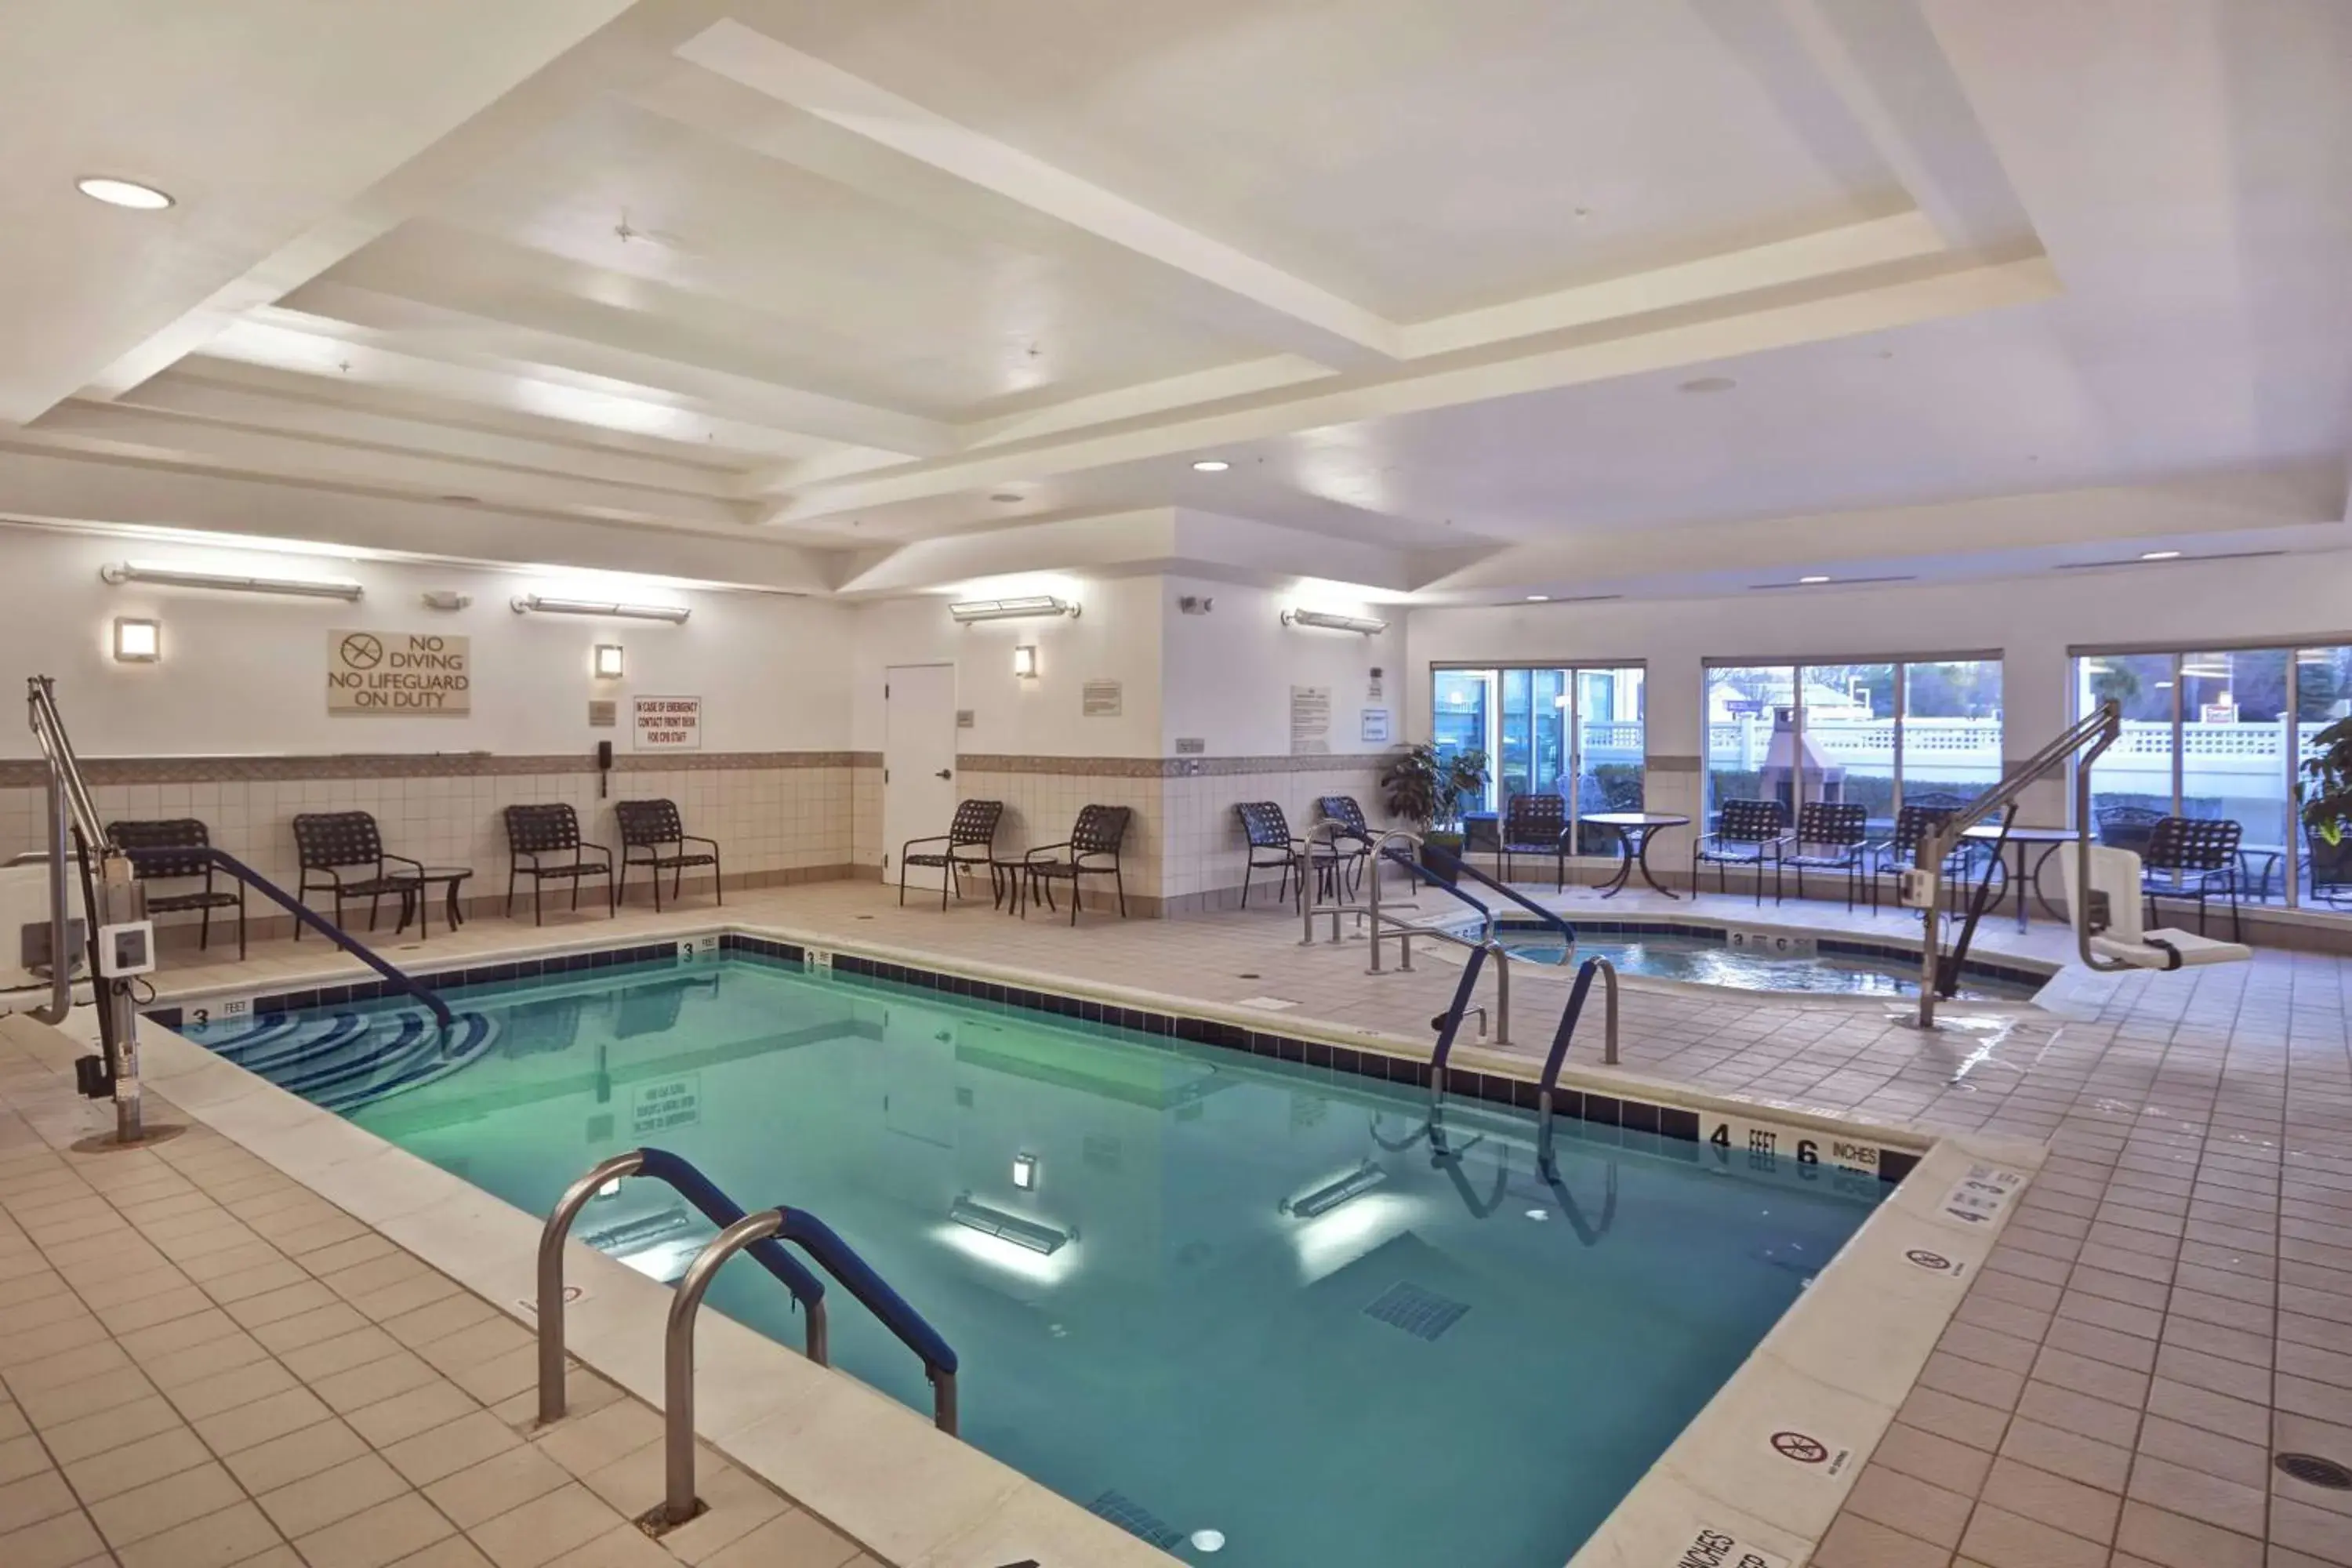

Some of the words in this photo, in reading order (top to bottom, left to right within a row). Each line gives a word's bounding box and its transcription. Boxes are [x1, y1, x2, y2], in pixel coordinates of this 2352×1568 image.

[409, 635, 444, 652] NO
[390, 653, 463, 670] DIVING
[328, 672, 363, 688] NO
[368, 673, 469, 691] LIFEGUARD
[355, 691, 387, 706] ON
[394, 692, 445, 707] DUTY
[193, 1008, 209, 1025] 3
[225, 1001, 245, 1013] FEET
[1710, 1123, 1731, 1147] 4
[1748, 1128, 1777, 1156] FEET
[1797, 1139, 1818, 1165] 6
[1832, 1142, 1878, 1165] INCHES
[1676, 1530, 1735, 1568] NCHES
